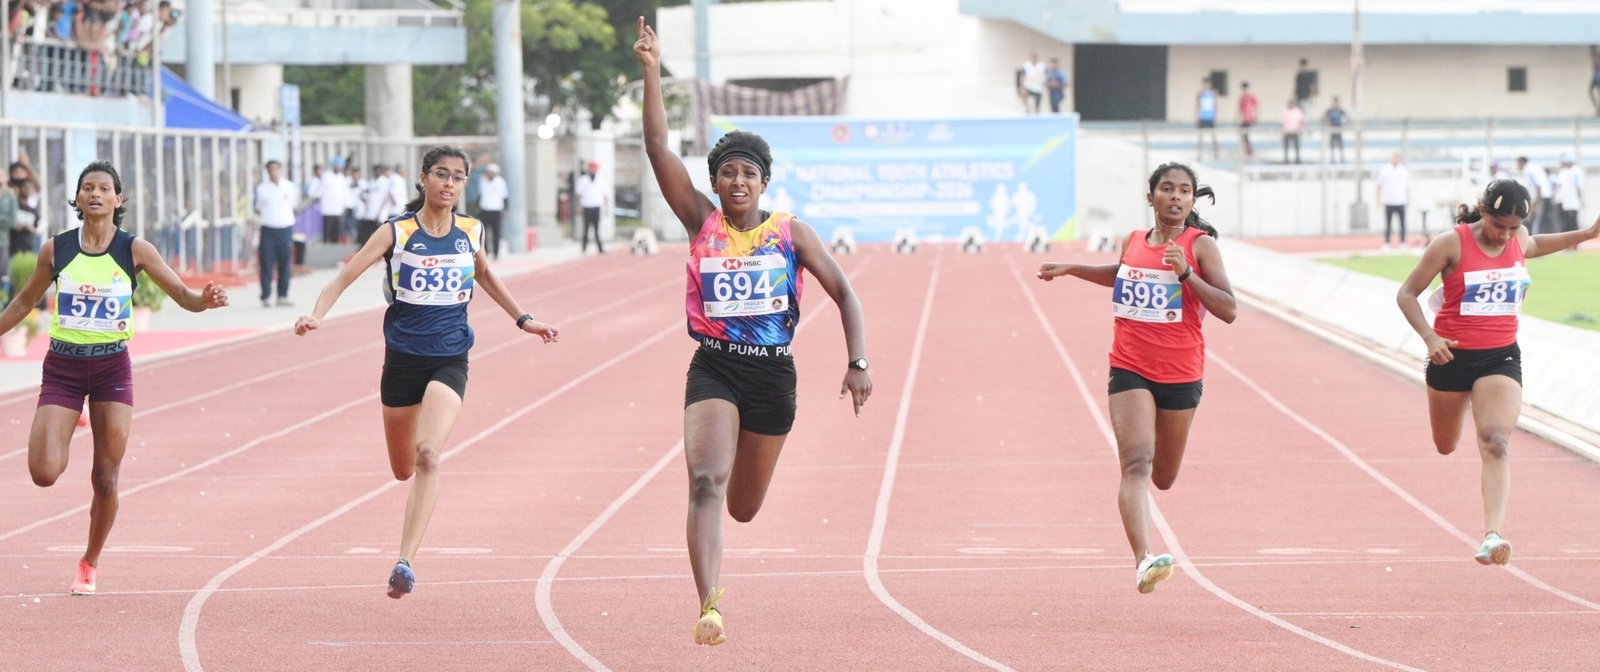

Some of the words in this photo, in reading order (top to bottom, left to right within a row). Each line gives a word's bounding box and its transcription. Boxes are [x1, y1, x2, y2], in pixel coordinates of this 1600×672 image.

[410, 267, 463, 292] 638
[713, 270, 774, 301] 694
[1474, 280, 1522, 303] 581
[70, 295, 120, 320] 579
[1121, 280, 1168, 310] 598
[50, 340, 88, 356] NIKE
[728, 343, 769, 357] PUMA
